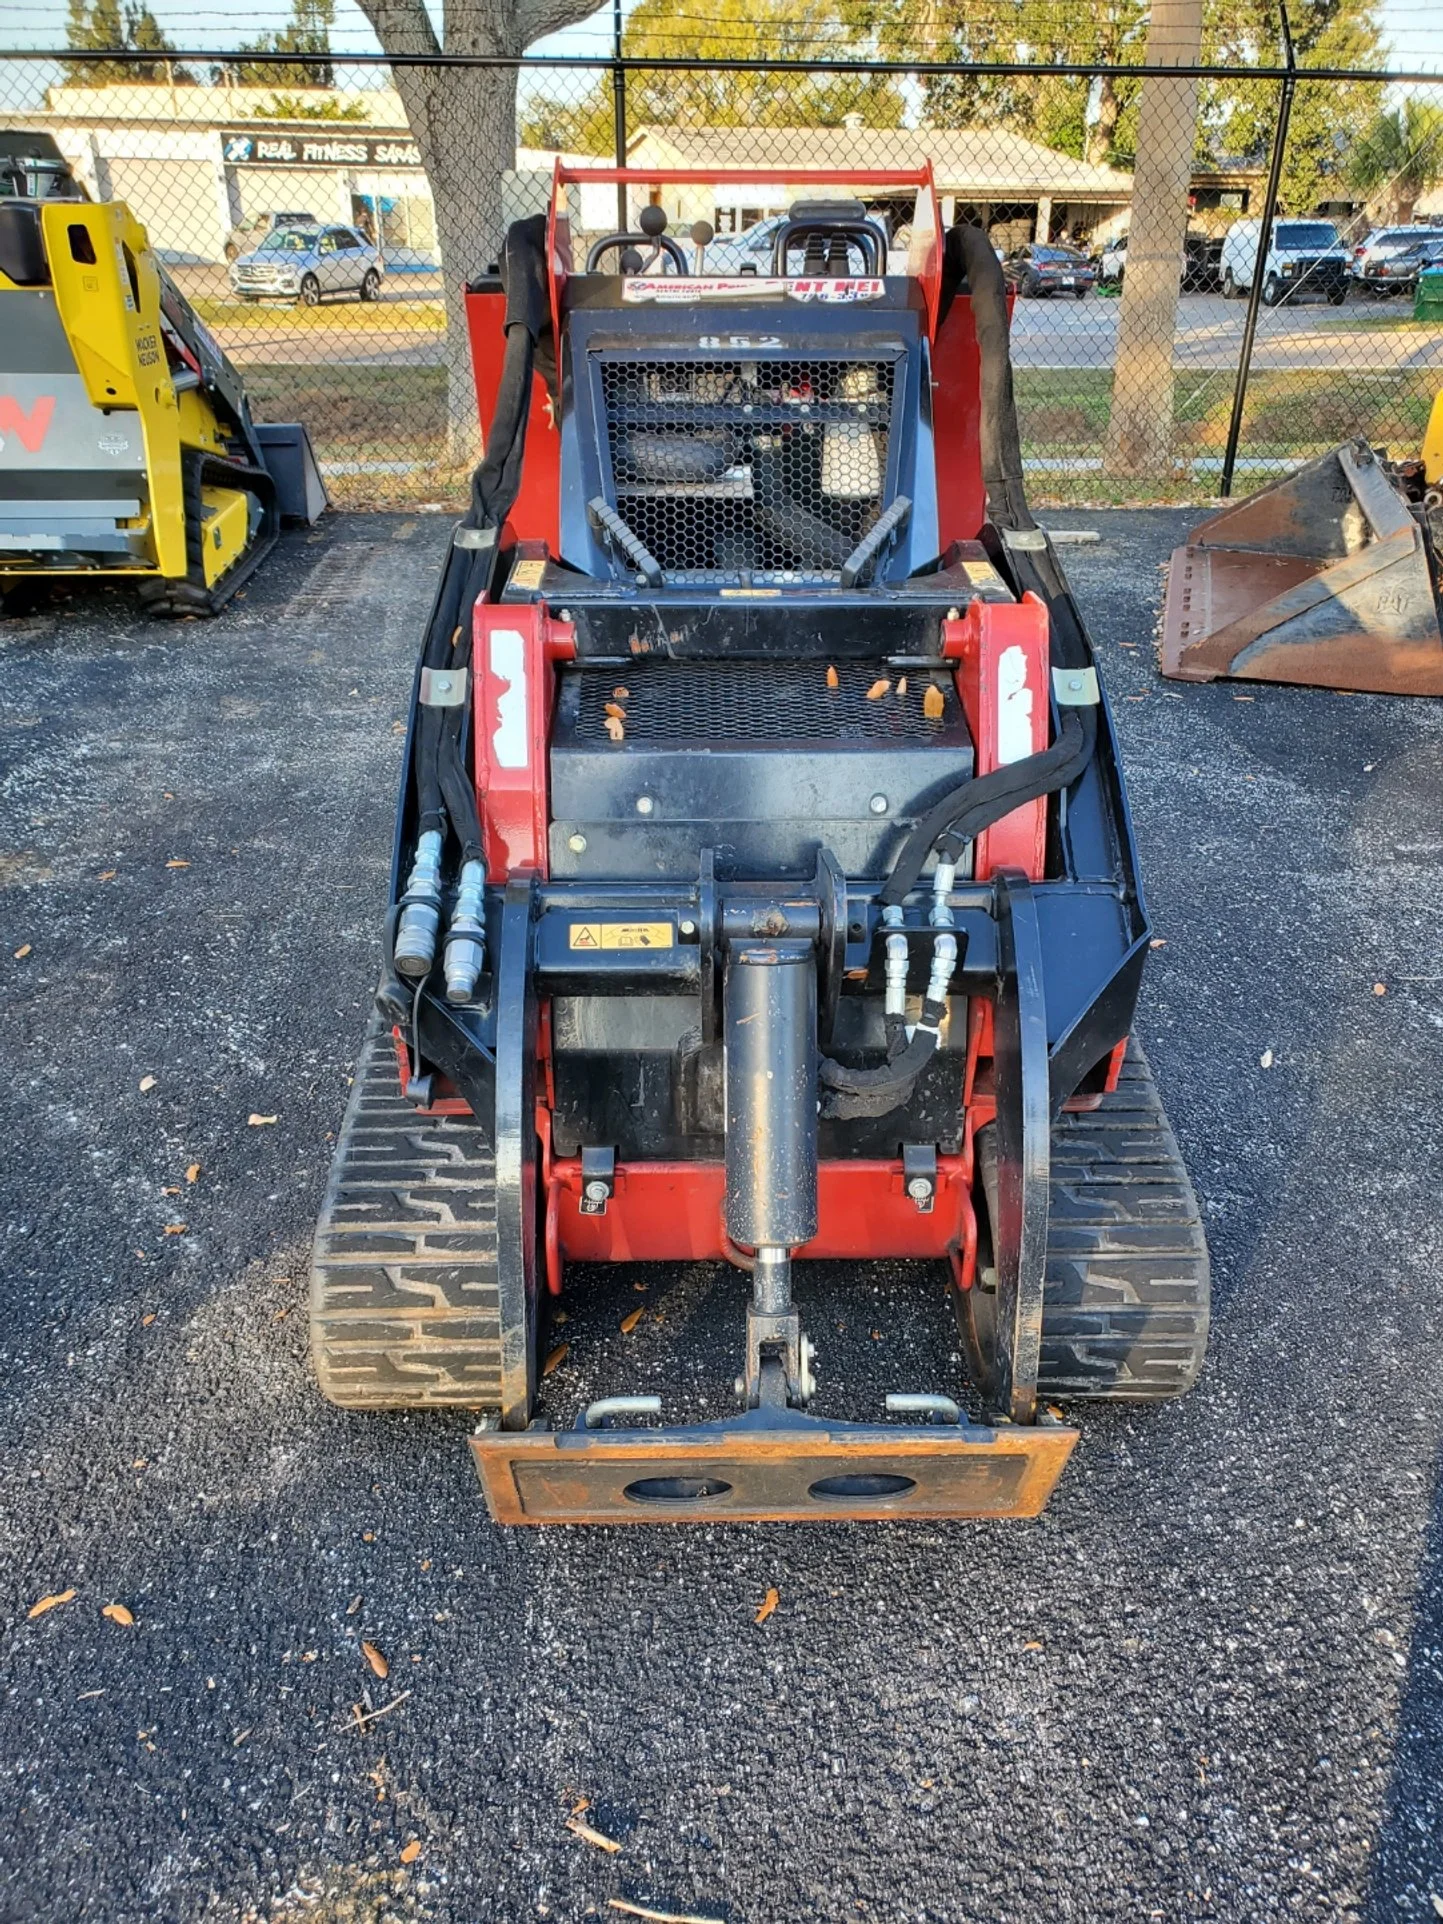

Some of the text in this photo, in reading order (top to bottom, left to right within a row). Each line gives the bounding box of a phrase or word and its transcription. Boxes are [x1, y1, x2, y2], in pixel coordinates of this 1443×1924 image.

[257, 140, 297, 160] REAL
[303, 141, 368, 162] FITNESS
[645, 283, 714, 291] AMERICAN
[699, 336, 784, 348] 852
